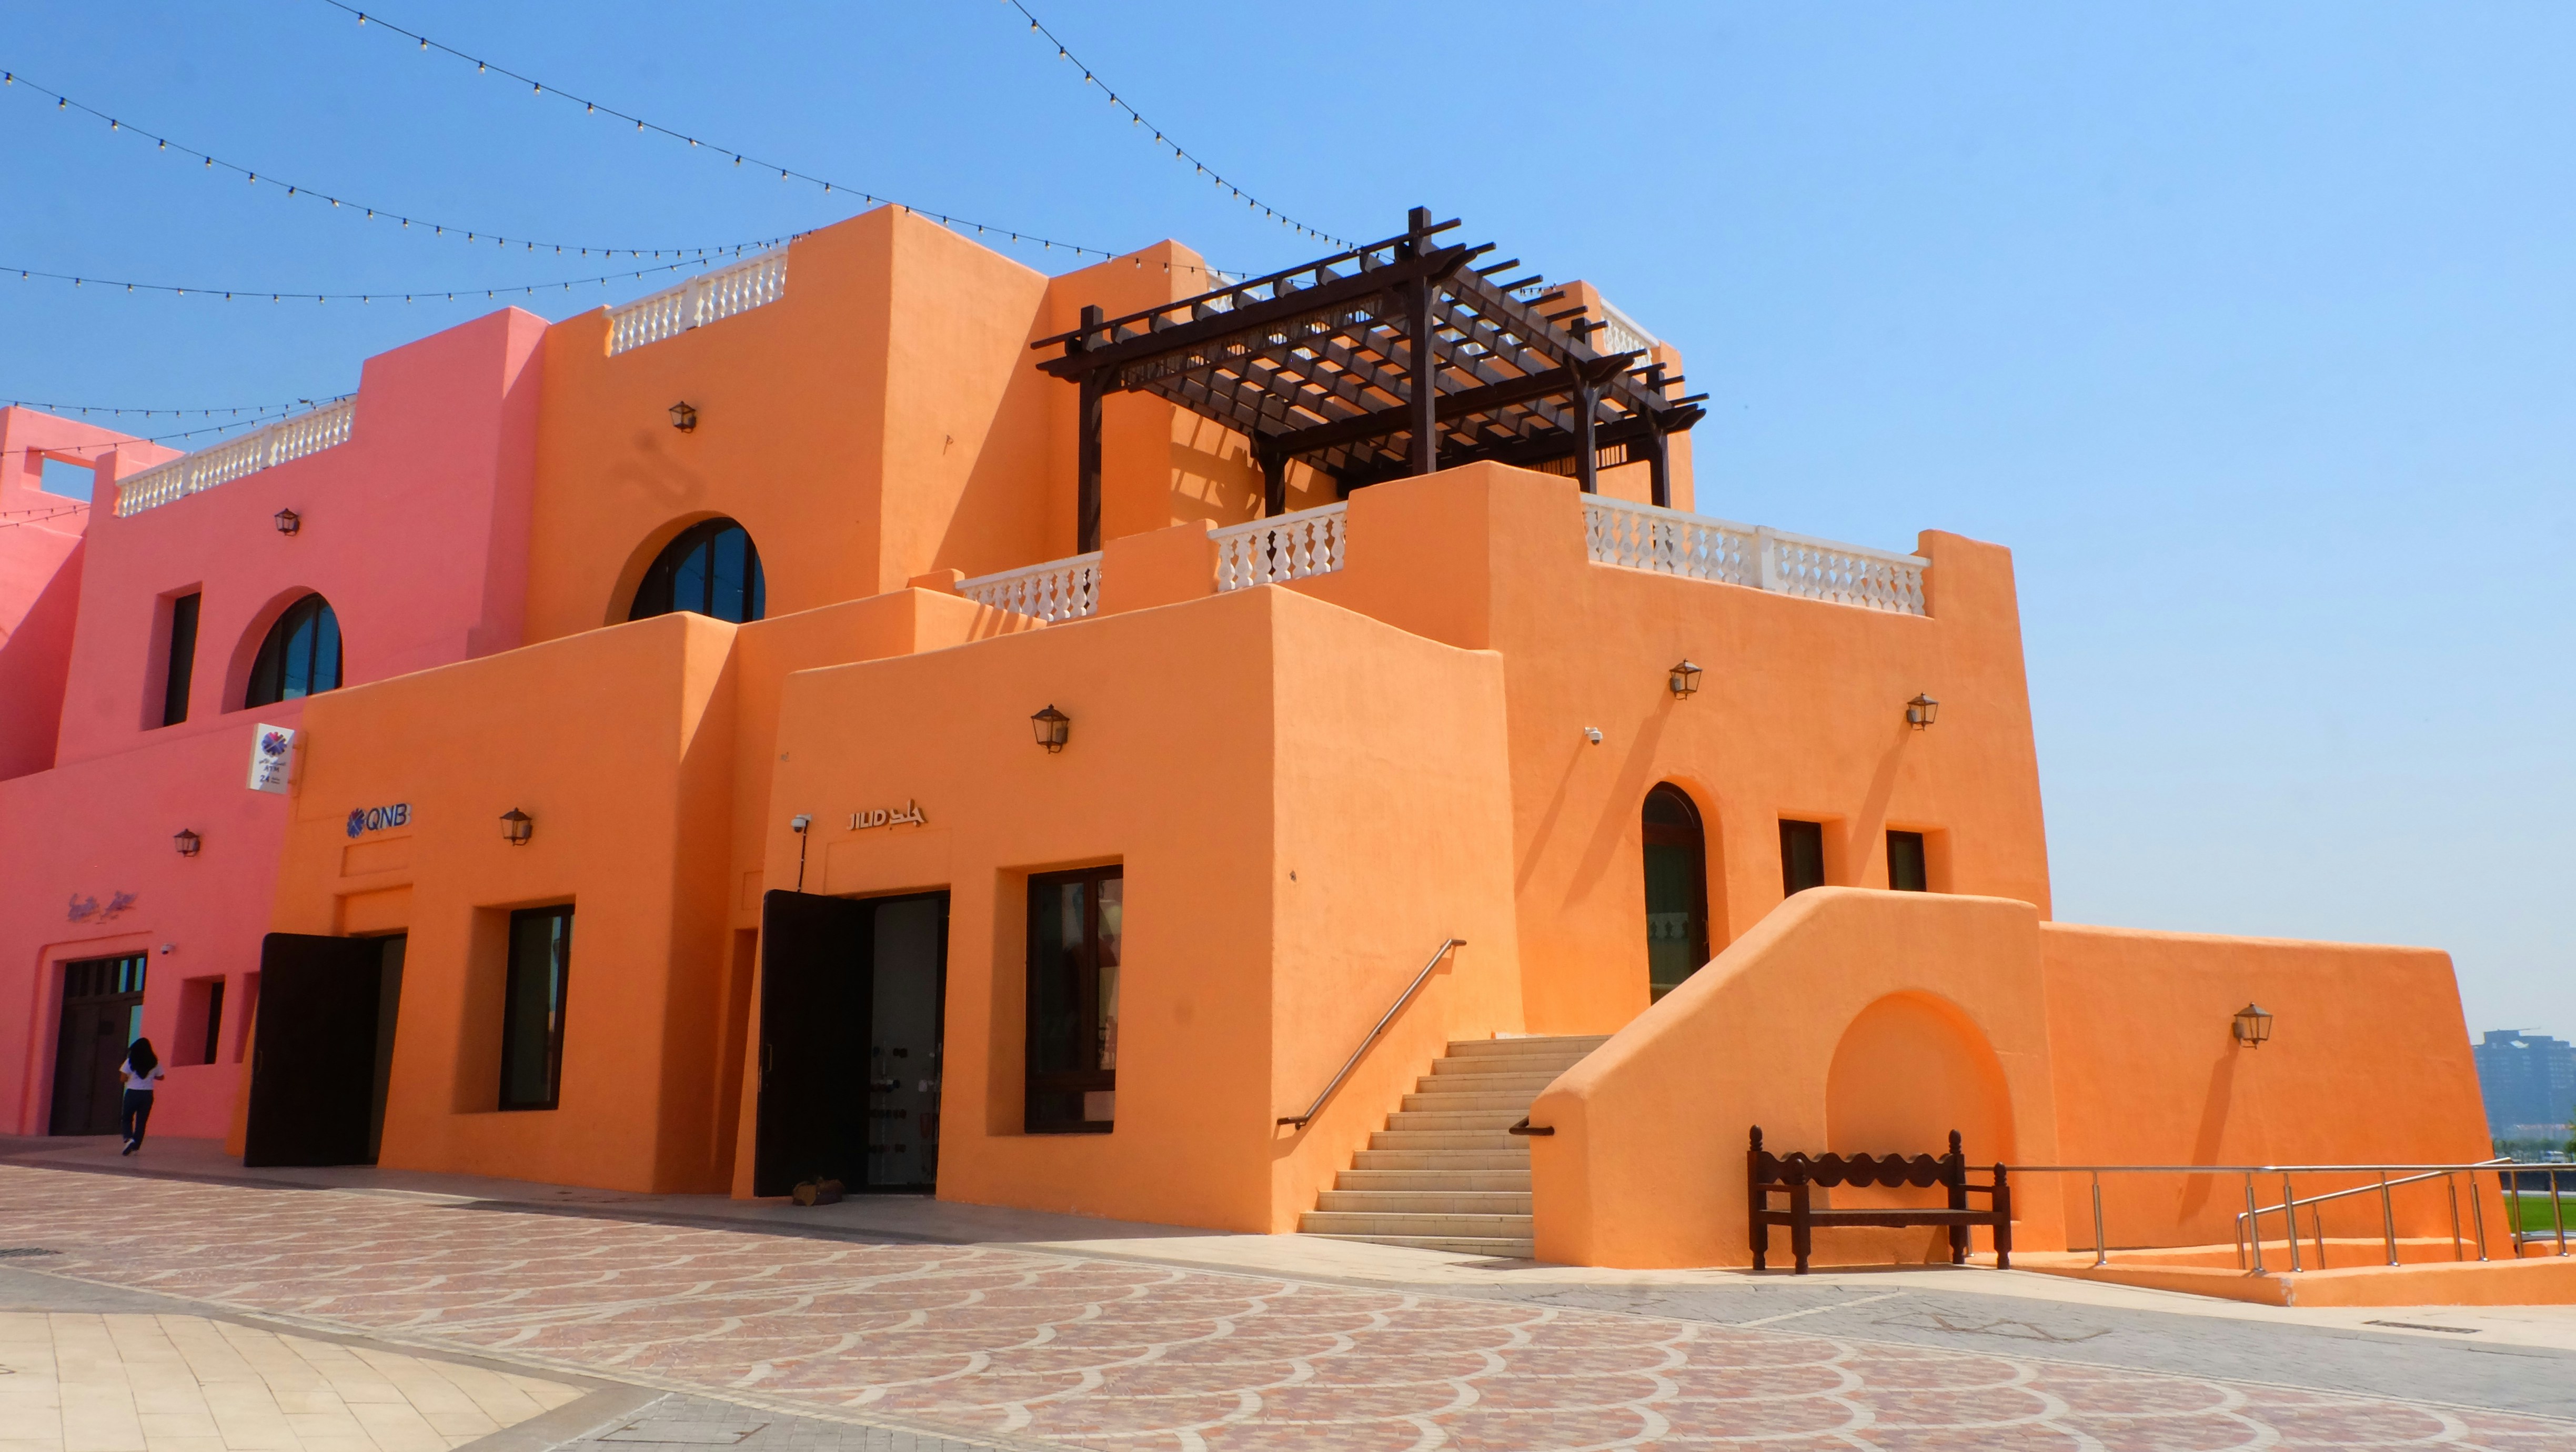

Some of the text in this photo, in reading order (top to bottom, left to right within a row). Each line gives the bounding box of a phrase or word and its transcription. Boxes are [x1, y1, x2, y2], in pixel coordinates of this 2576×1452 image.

[366, 803, 409, 831] QNB
[846, 809, 887, 831] JILID
[889, 799, 925, 826] جلد
